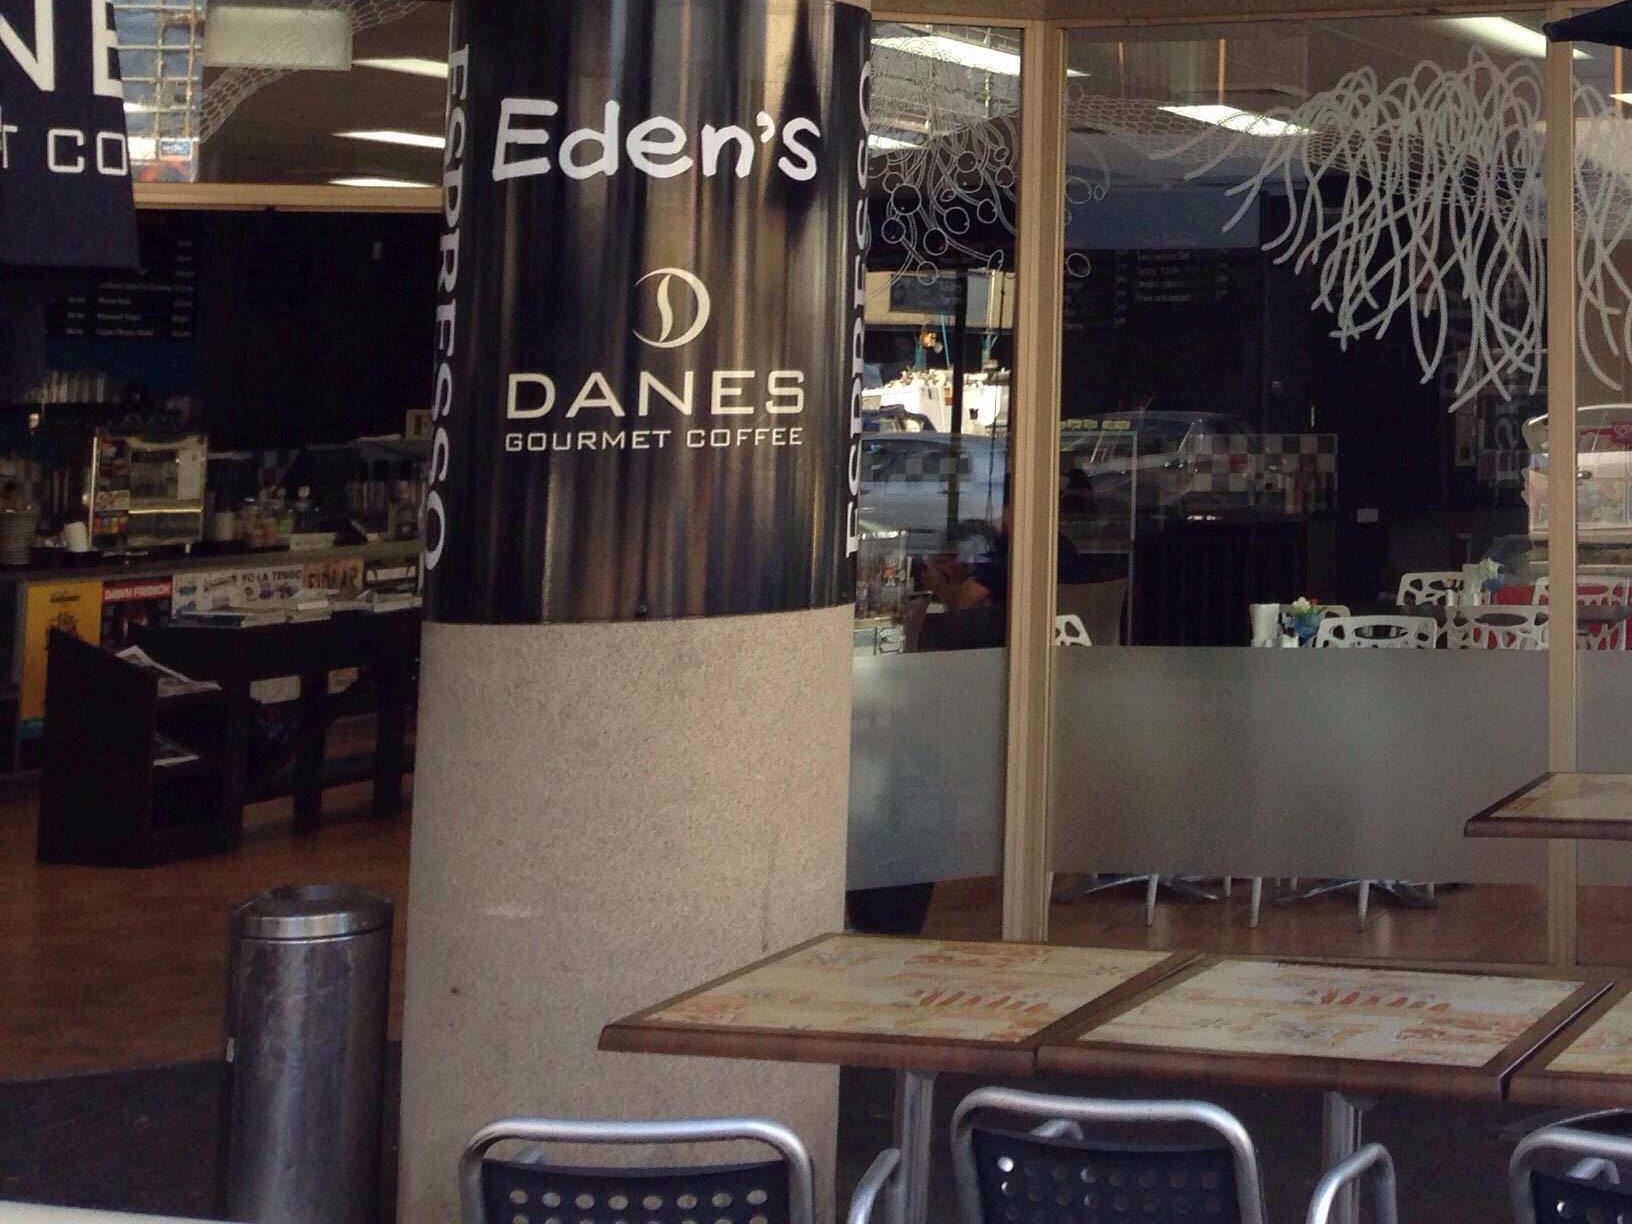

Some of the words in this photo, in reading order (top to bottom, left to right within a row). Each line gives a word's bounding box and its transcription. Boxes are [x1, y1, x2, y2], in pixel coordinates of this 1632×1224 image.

[492, 98, 821, 182] Eden's
[506, 370, 804, 419] DANES
[505, 428, 672, 452] GOURMET
[685, 426, 803, 449] COFFEE
